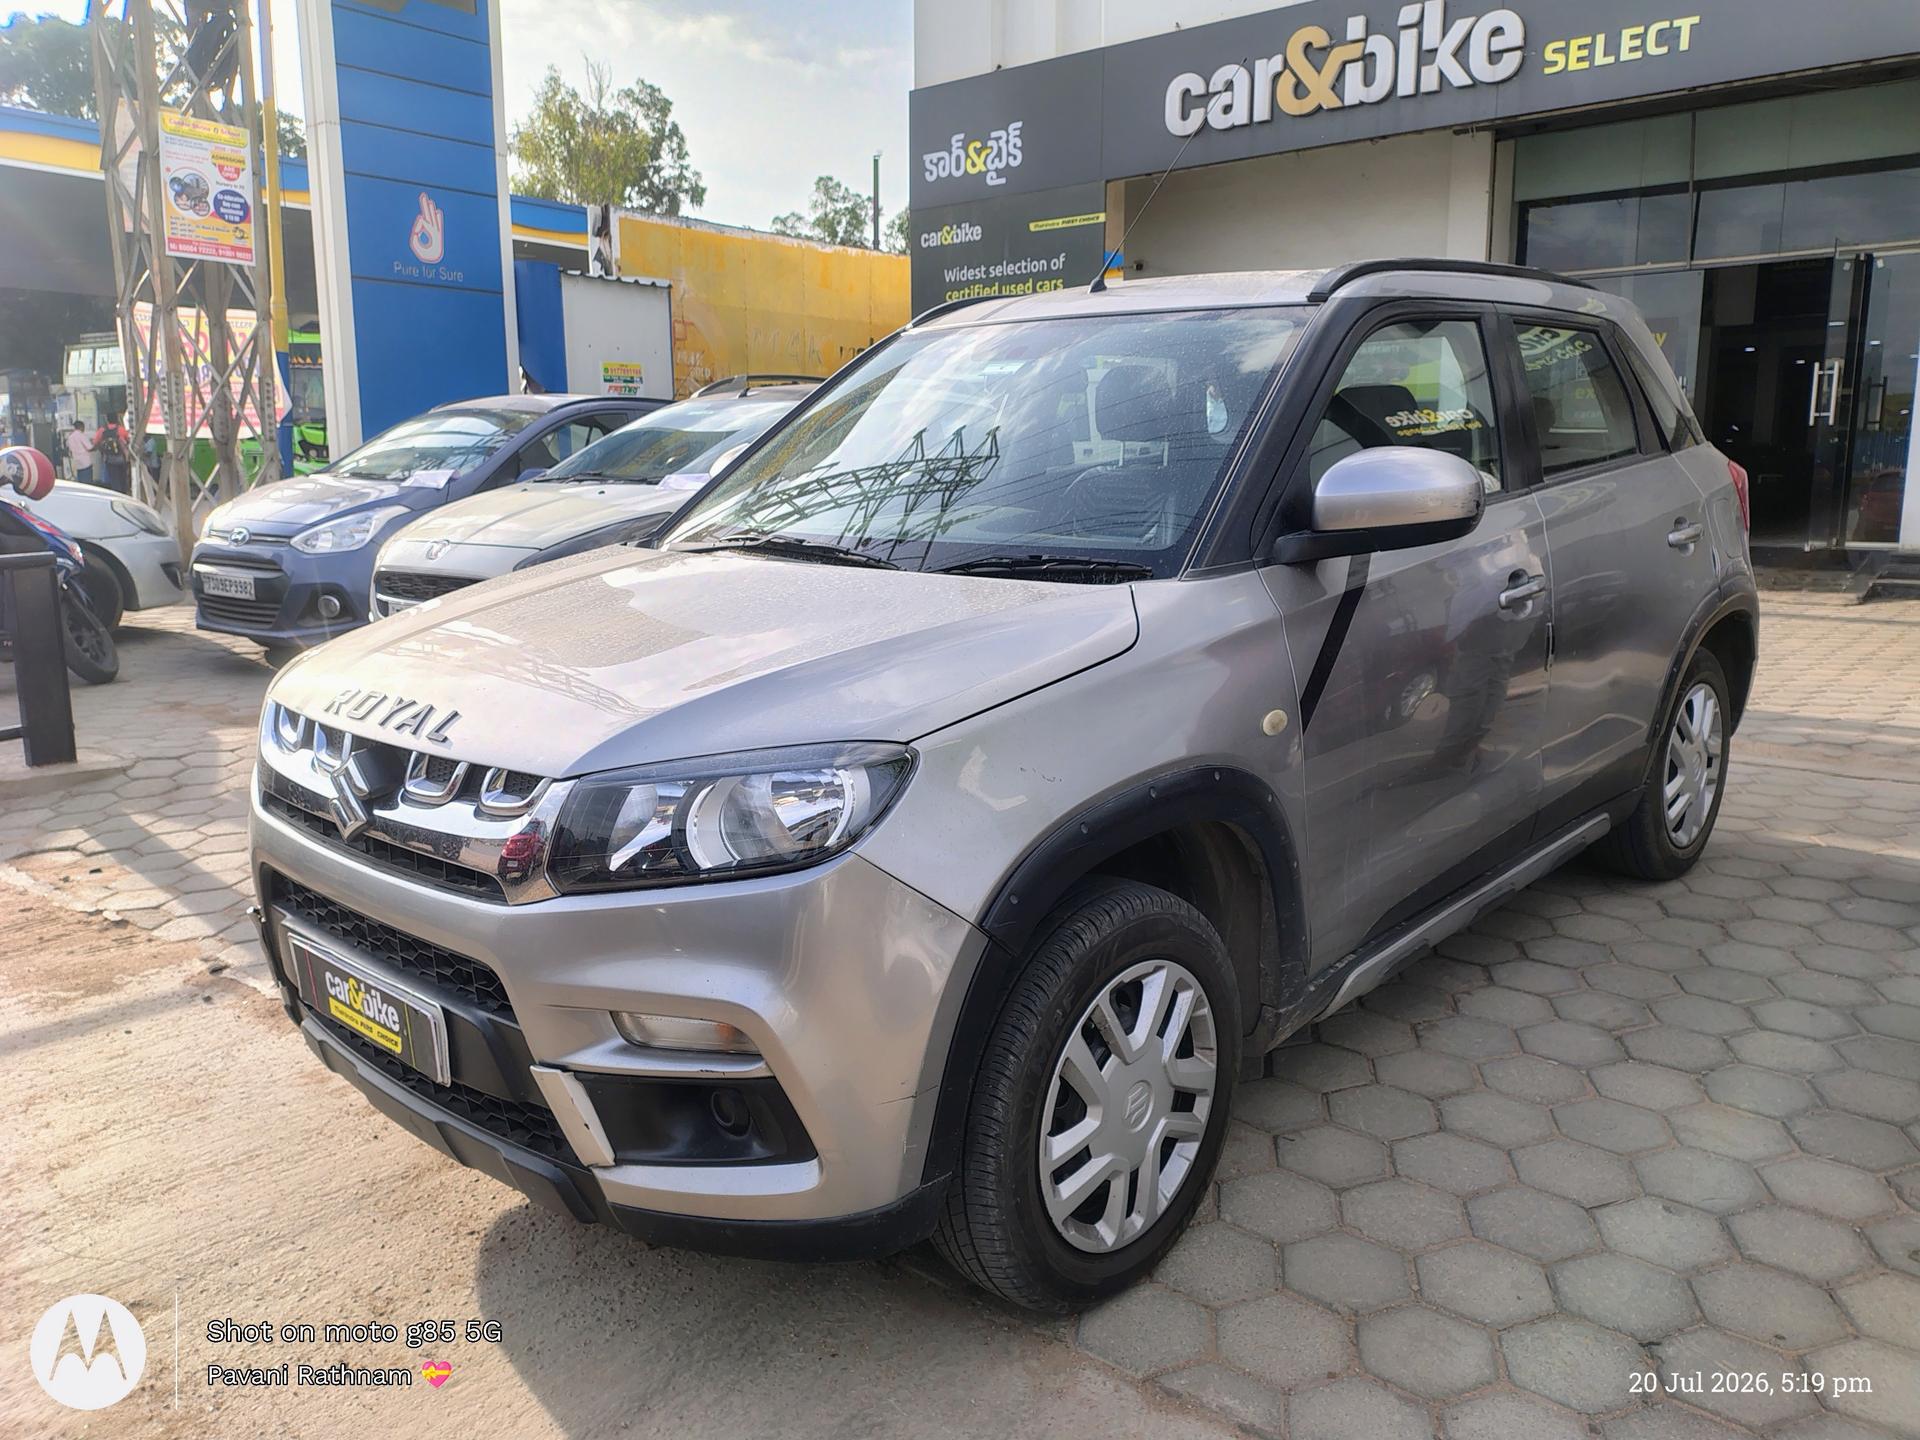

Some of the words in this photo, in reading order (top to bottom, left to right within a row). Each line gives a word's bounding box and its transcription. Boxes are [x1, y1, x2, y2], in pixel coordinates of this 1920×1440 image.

[1164, 0, 1526, 137] car&bike
[1543, 16, 1701, 75] SELECT
[920, 222, 983, 248] car&bike
[393, 260, 419, 277] Pure
[422, 265, 436, 277] for
[439, 266, 464, 282] Sure
[944, 265, 987, 283] Widest
[989, 257, 1047, 278] selection
[1050, 253, 1066, 270] of
[945, 281, 999, 302] certified
[1001, 278, 1033, 297] used
[1036, 278, 1064, 293] cars
[324, 689, 461, 743] ROYAL
[325, 971, 400, 1032] car&bike
